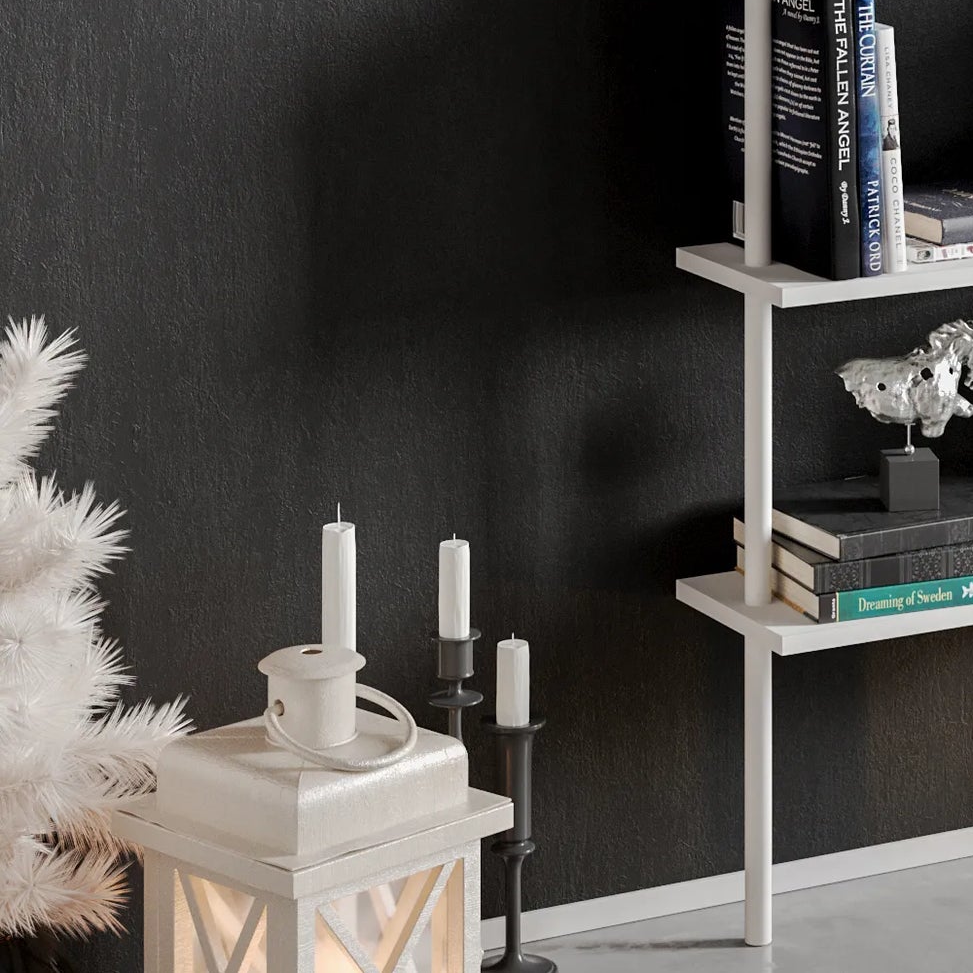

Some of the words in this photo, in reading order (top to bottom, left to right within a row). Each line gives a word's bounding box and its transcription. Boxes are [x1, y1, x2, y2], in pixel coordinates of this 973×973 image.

[858, 3, 874, 32] THE
[836, 38, 849, 105] FALLEN
[859, 34, 876, 98] CURTAIN
[838, 109, 850, 171] ANGEL
[839, 180, 848, 192] By
[890, 158, 898, 193] COCO
[840, 192, 849, 217] Danny
[868, 180, 880, 238] PATRICK
[893, 199, 902, 248] CHANEL
[869, 242, 881, 272] ORD
[858, 594, 904, 612] Dreaming
[905, 592, 915, 606] of
[917, 587, 953, 604] Sweden
